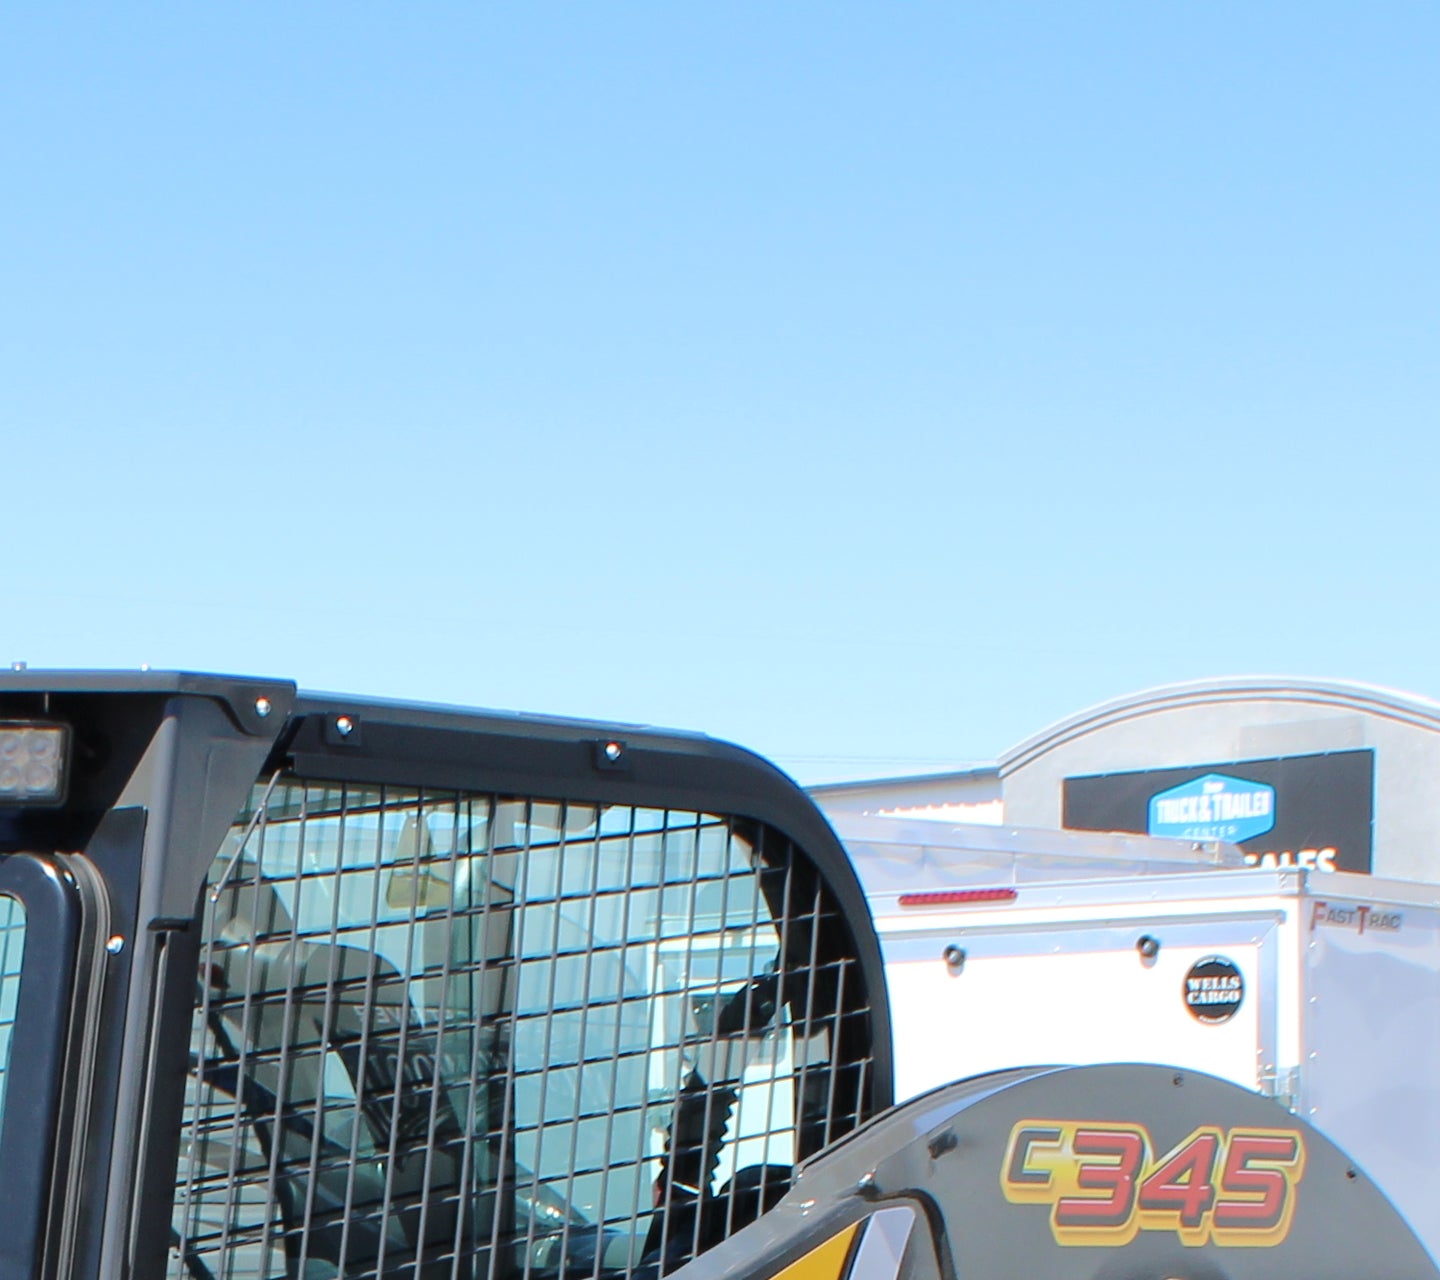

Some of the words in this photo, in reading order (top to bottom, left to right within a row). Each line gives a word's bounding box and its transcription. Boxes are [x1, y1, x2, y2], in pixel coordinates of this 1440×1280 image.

[1187, 975, 1240, 991] WELLS
[1186, 989, 1241, 1006] CARGO
[1003, 1120, 1306, 1246] C345
